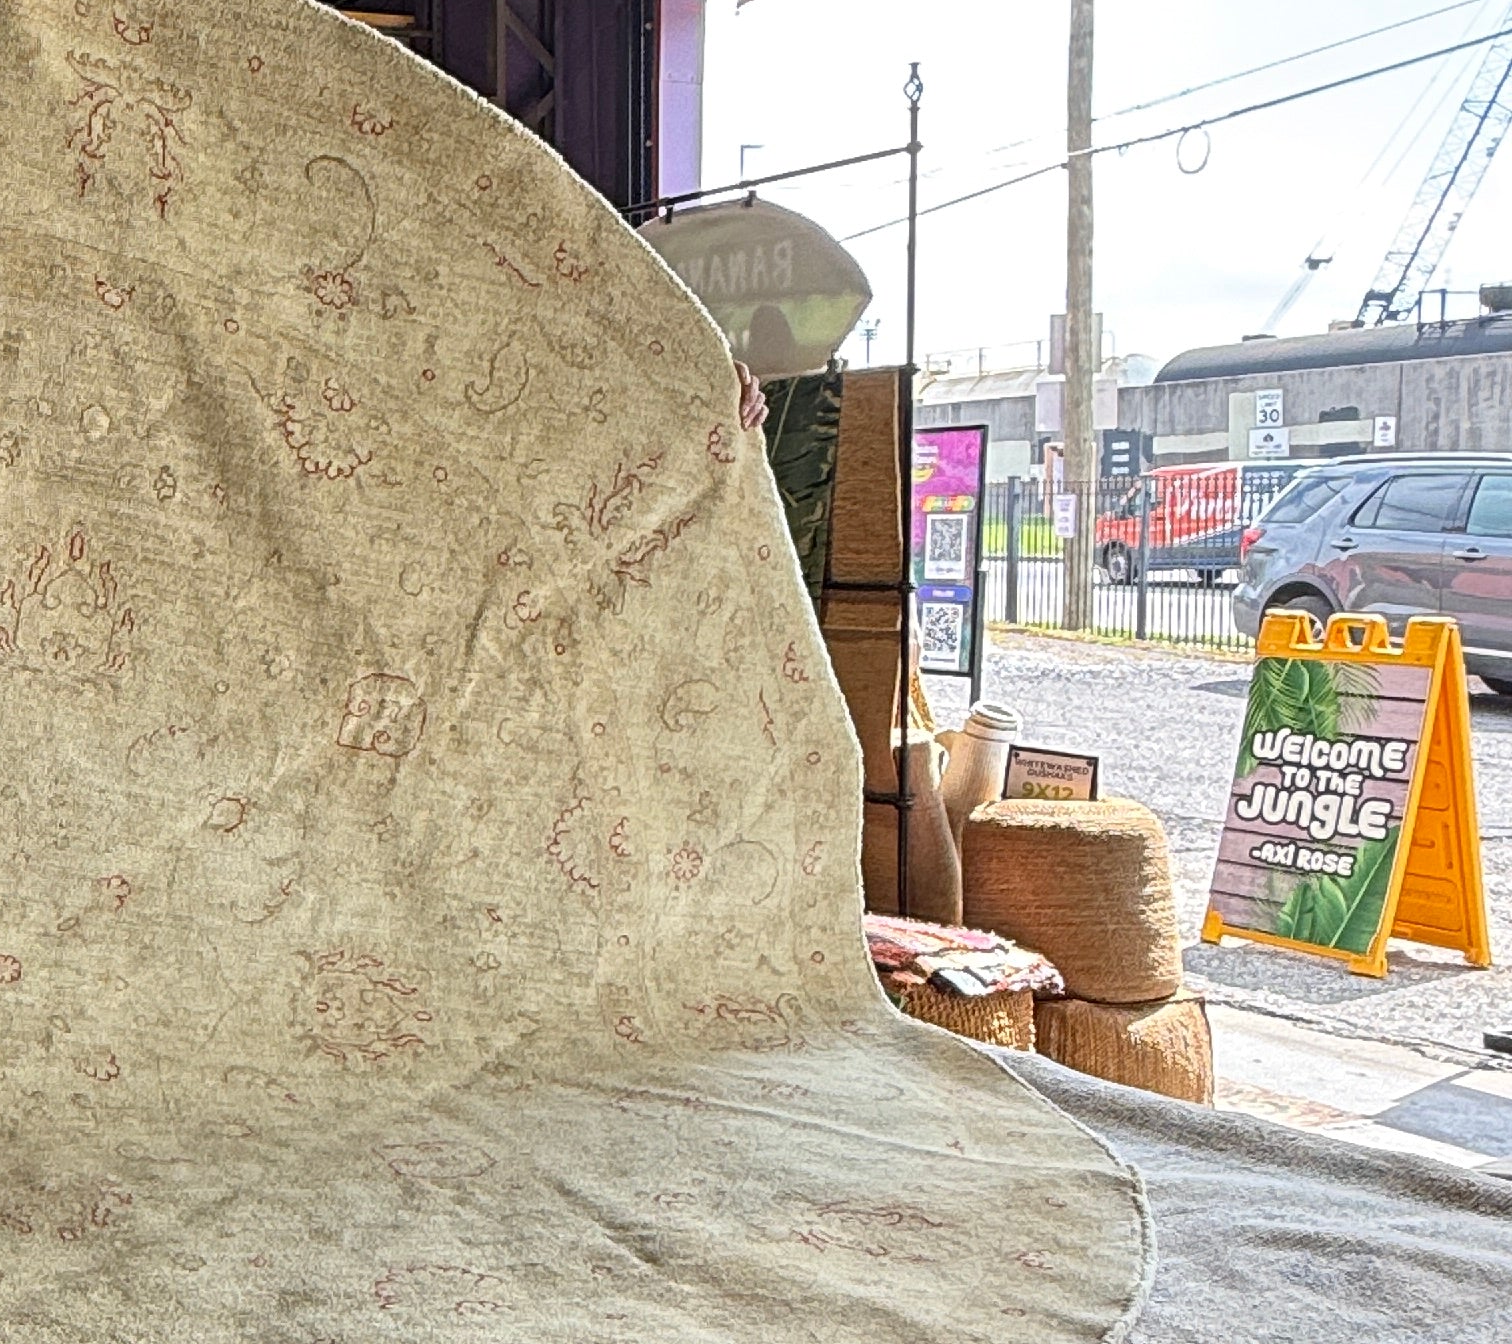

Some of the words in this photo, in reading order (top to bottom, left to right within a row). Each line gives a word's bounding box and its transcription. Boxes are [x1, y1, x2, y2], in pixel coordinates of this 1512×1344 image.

[1258, 409, 1280, 424] 30
[1281, 765, 1311, 788] TO
[1021, 781, 1075, 801] 9X12
[1296, 848, 1354, 877] ROSE
